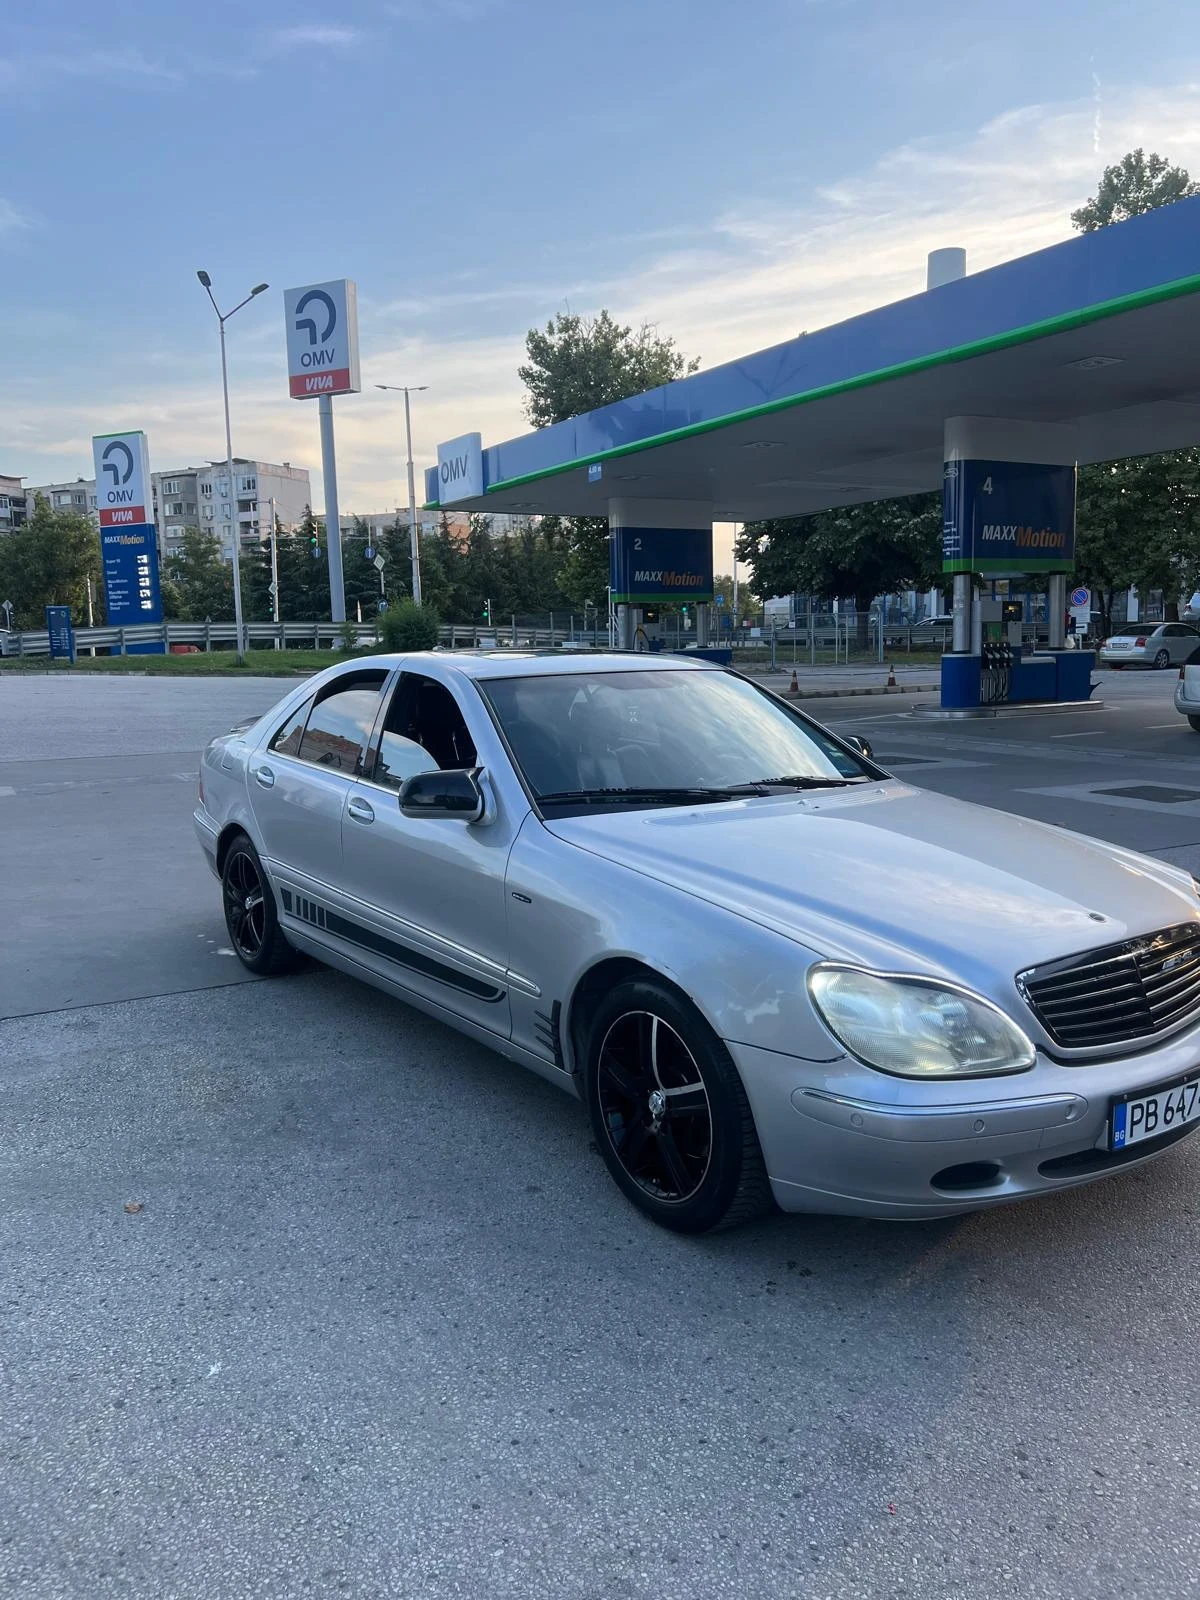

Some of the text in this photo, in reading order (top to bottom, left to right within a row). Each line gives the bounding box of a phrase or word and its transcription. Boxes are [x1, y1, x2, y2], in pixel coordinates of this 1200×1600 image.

[300, 348, 335, 368] OMV
[305, 375, 333, 391] VIVA
[440, 455, 468, 484] OMV
[983, 476, 993, 495] 4
[107, 489, 134, 503] OMV
[111, 510, 133, 522] VIVA
[634, 538, 642, 550] 2
[1130, 1082, 1200, 1138] PB 647
[1114, 1129, 1125, 1142] BG
